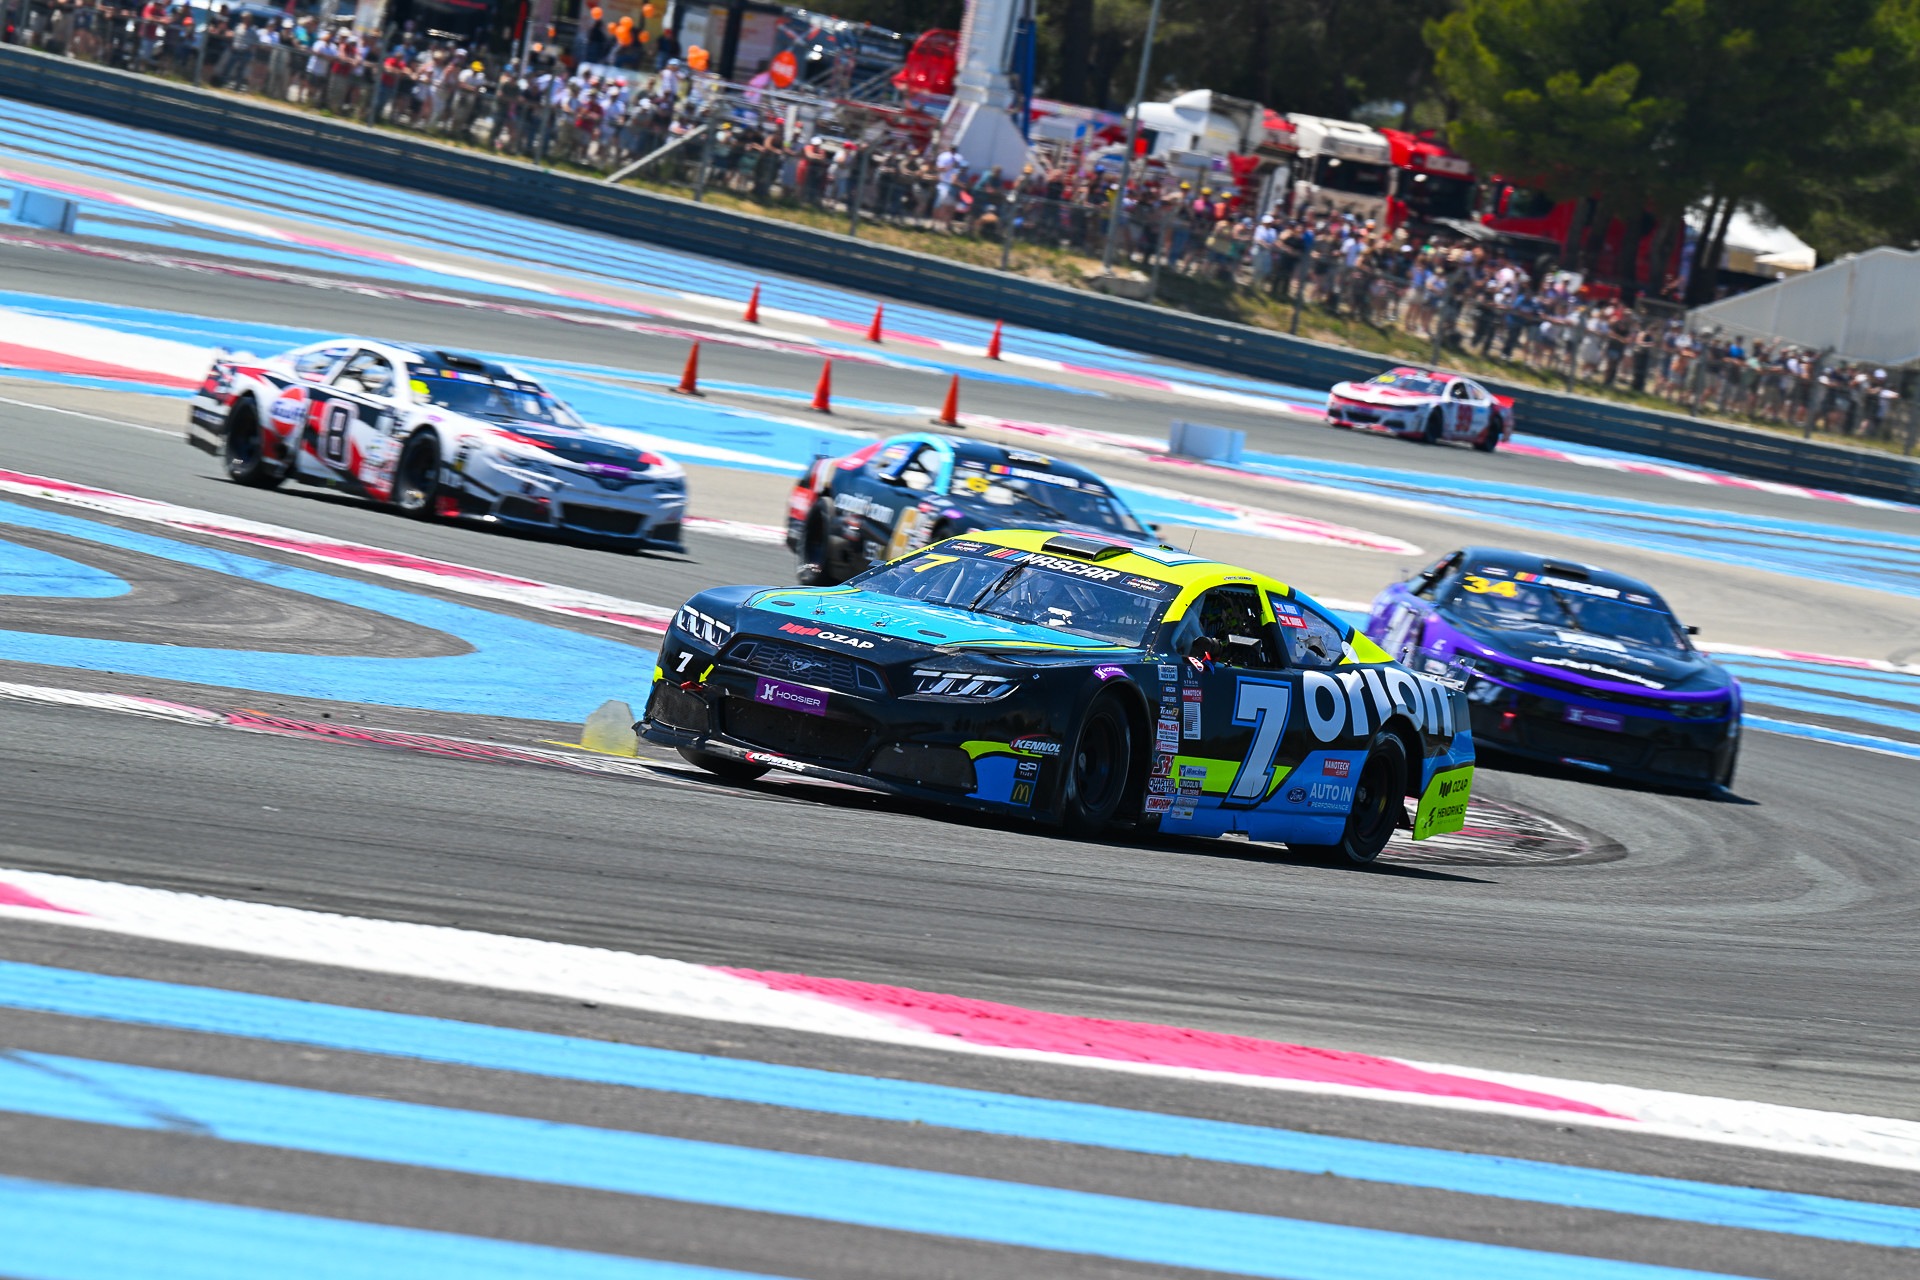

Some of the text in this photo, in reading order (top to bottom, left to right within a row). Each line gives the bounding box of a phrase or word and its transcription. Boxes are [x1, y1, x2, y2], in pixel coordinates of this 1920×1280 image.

[327, 405, 349, 463] 8
[913, 553, 961, 573] 7
[1015, 552, 1121, 582] NASCAR
[1462, 575, 1519, 598] 34
[817, 631, 875, 649] OZAP
[676, 651, 694, 673] 7
[776, 690, 821, 706] HOOSIER
[1014, 739, 1061, 753] KENNOL
[1231, 675, 1292, 804] 7
[749, 752, 805, 769] KENNOL
[1324, 760, 1350, 771] NANOTECH
[1150, 778, 1175, 788] QUARTER
[1153, 783, 1175, 793] MASTER
[1452, 778, 1468, 793] OZAP
[1309, 782, 1353, 802] AUTO IN
[1147, 797, 1172, 810] SIMPSON
[1311, 801, 1349, 811] PERFORMANCE
[1437, 803, 1464, 818] HENDRIKS
